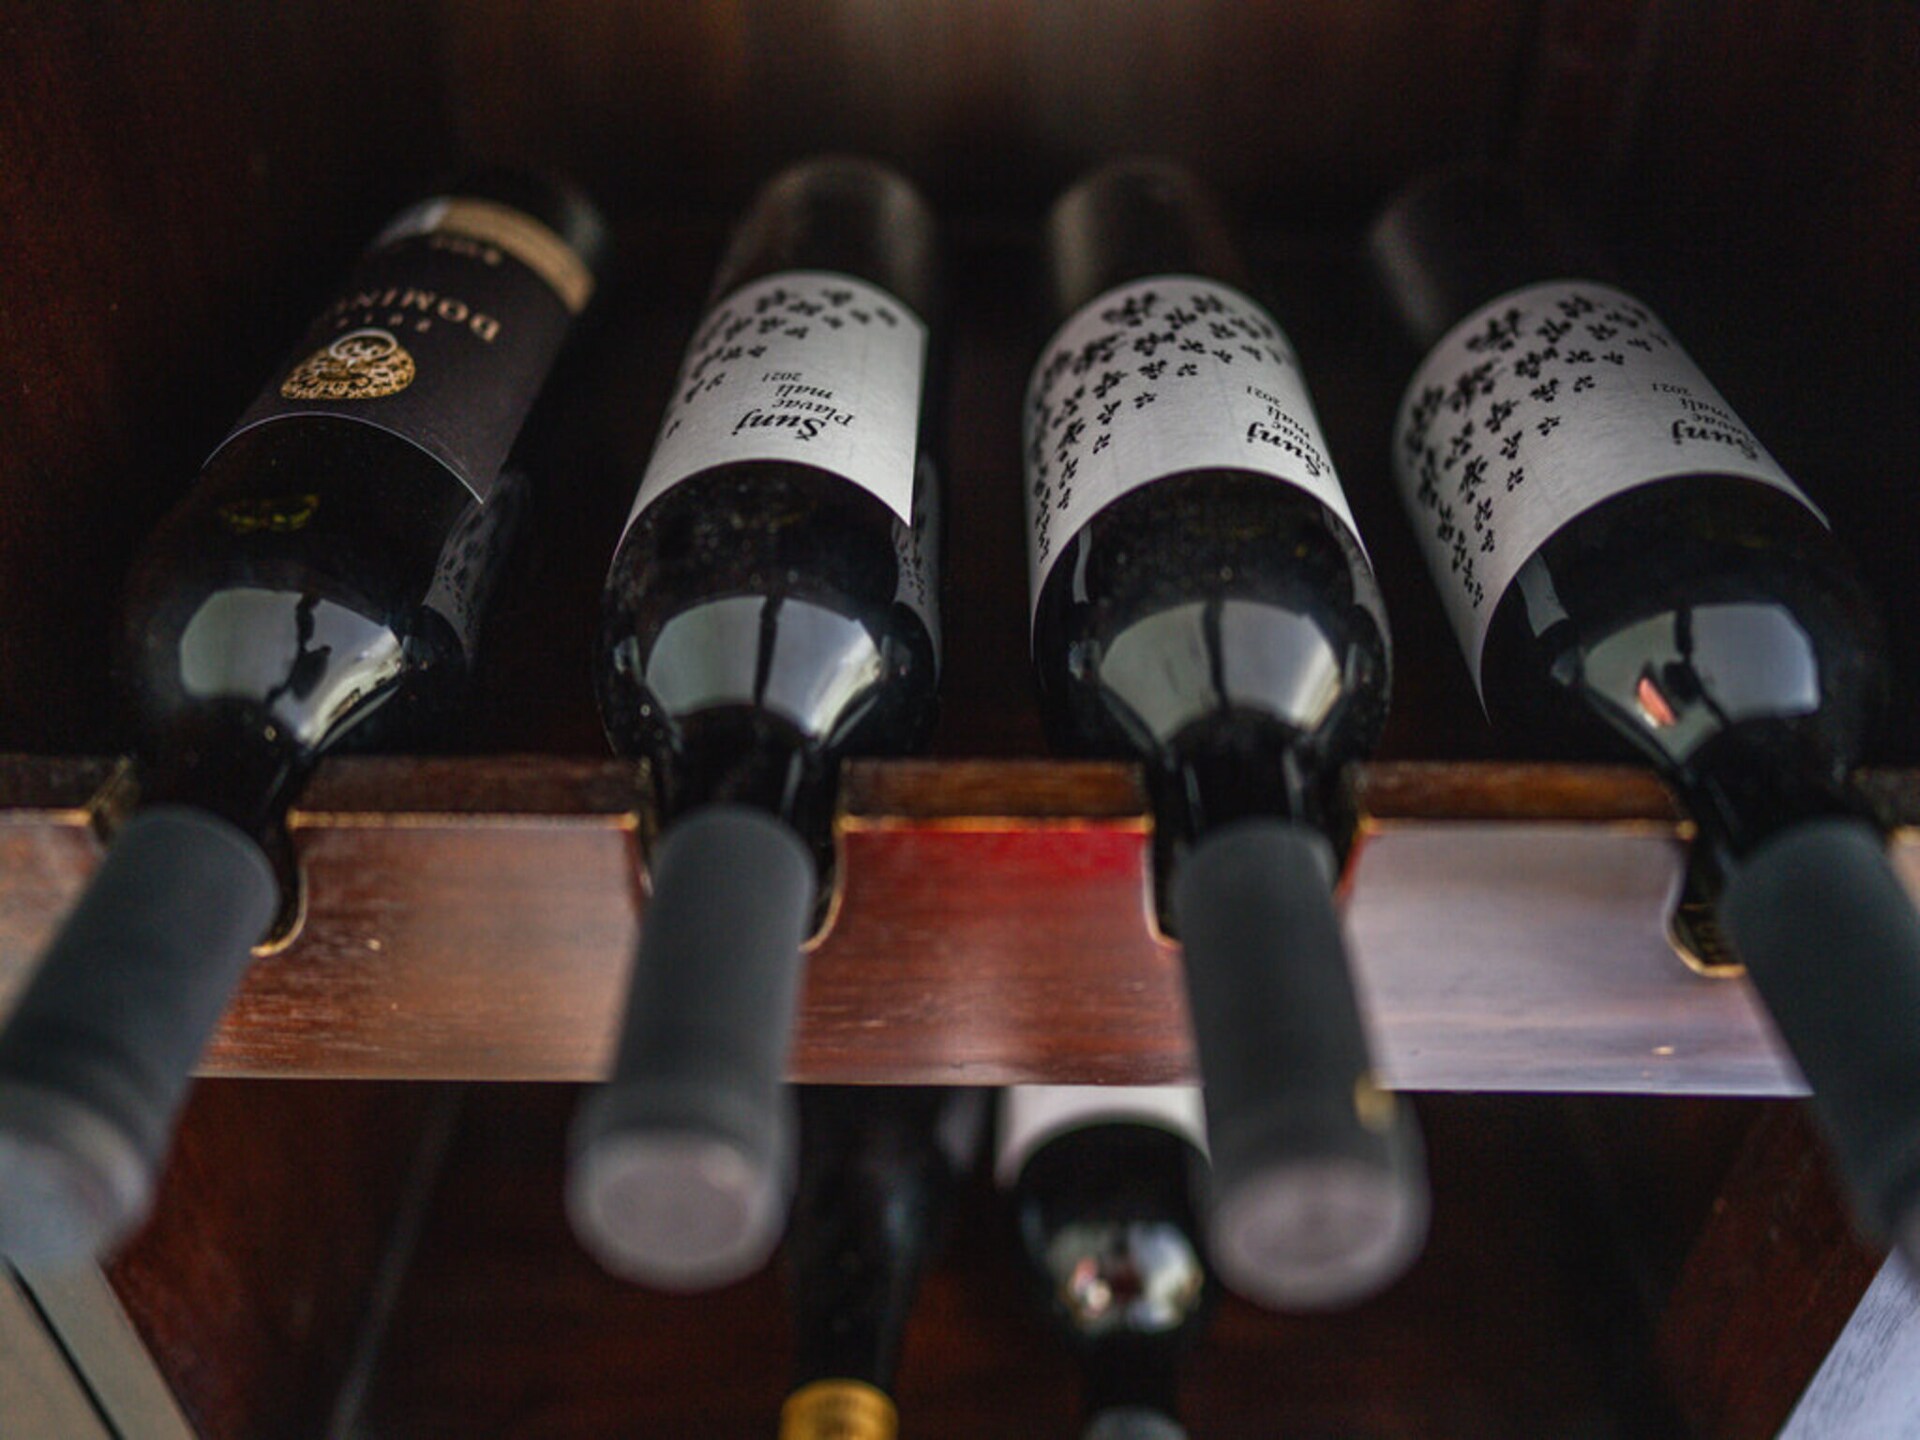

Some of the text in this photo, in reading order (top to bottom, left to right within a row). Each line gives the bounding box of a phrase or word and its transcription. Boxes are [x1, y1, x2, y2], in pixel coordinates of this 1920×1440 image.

[762, 372, 803, 382] 2021
[775, 384, 833, 399] mali
[1246, 385, 1281, 408] 2021
[1651, 382, 1692, 397] 2021
[771, 399, 854, 426] Plavac
[1680, 398, 1730, 420] mali
[731, 408, 827, 441] Šunj
[1266, 404, 1310, 441] mali
